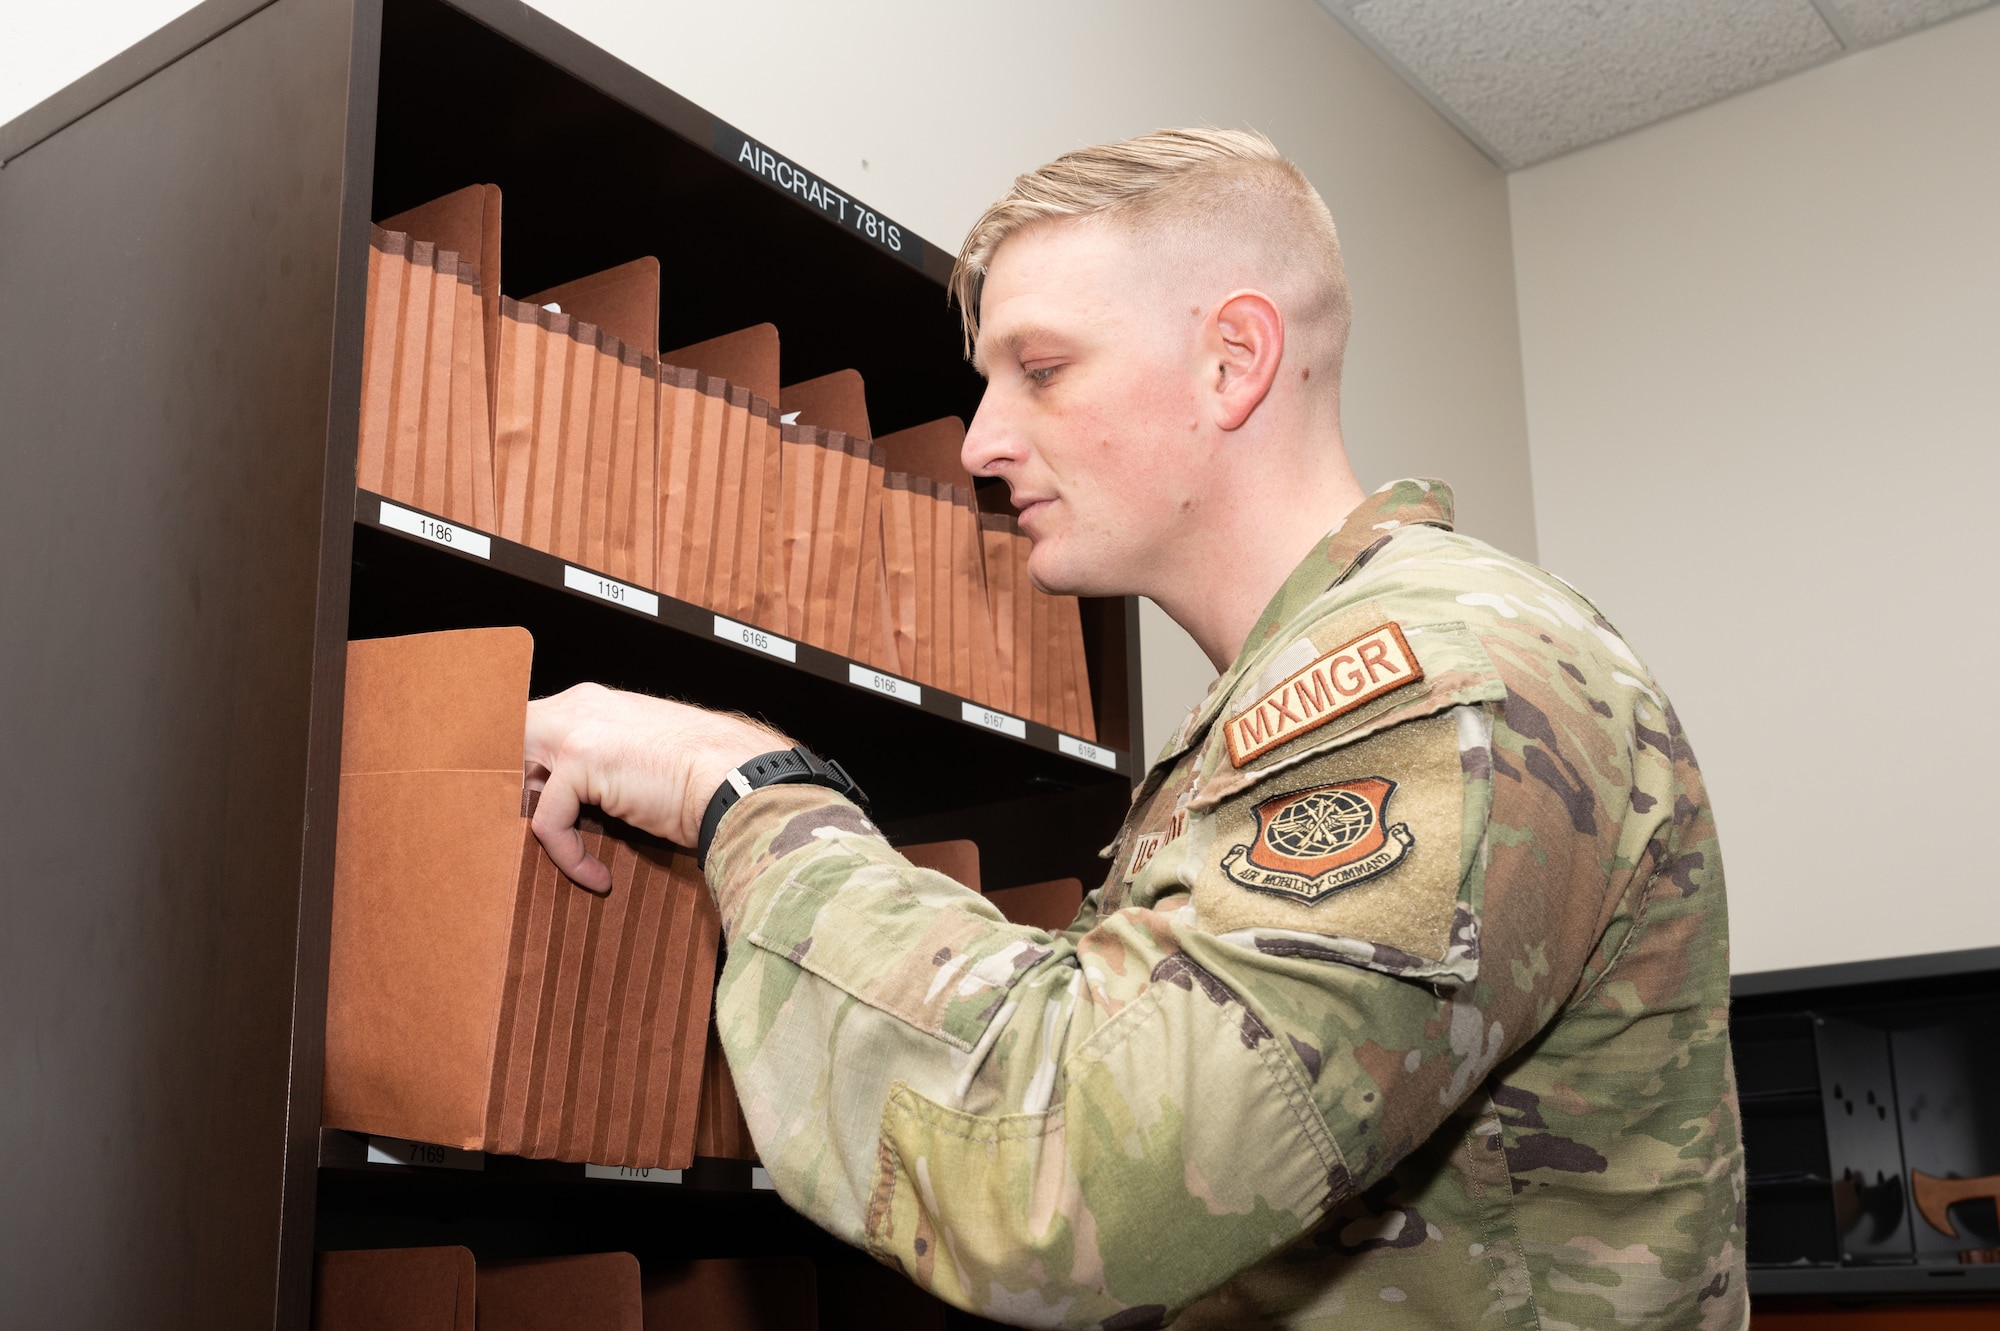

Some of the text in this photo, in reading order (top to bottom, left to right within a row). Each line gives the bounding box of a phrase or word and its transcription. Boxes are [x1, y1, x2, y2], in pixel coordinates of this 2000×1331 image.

[738, 141, 901, 251] AIRCRAFT 781S
[420, 519, 453, 543] 1186
[598, 580, 625, 602] 1191
[742, 629, 768, 650] 6165
[874, 675, 897, 694] 6166
[1238, 639, 1400, 751] MXMGR
[984, 712, 1004, 728] 6167
[1078, 743, 1097, 760] 6168
[1238, 853, 1392, 894] AIR MOBILITY COMMAND
[410, 1144, 445, 1164] 7169
